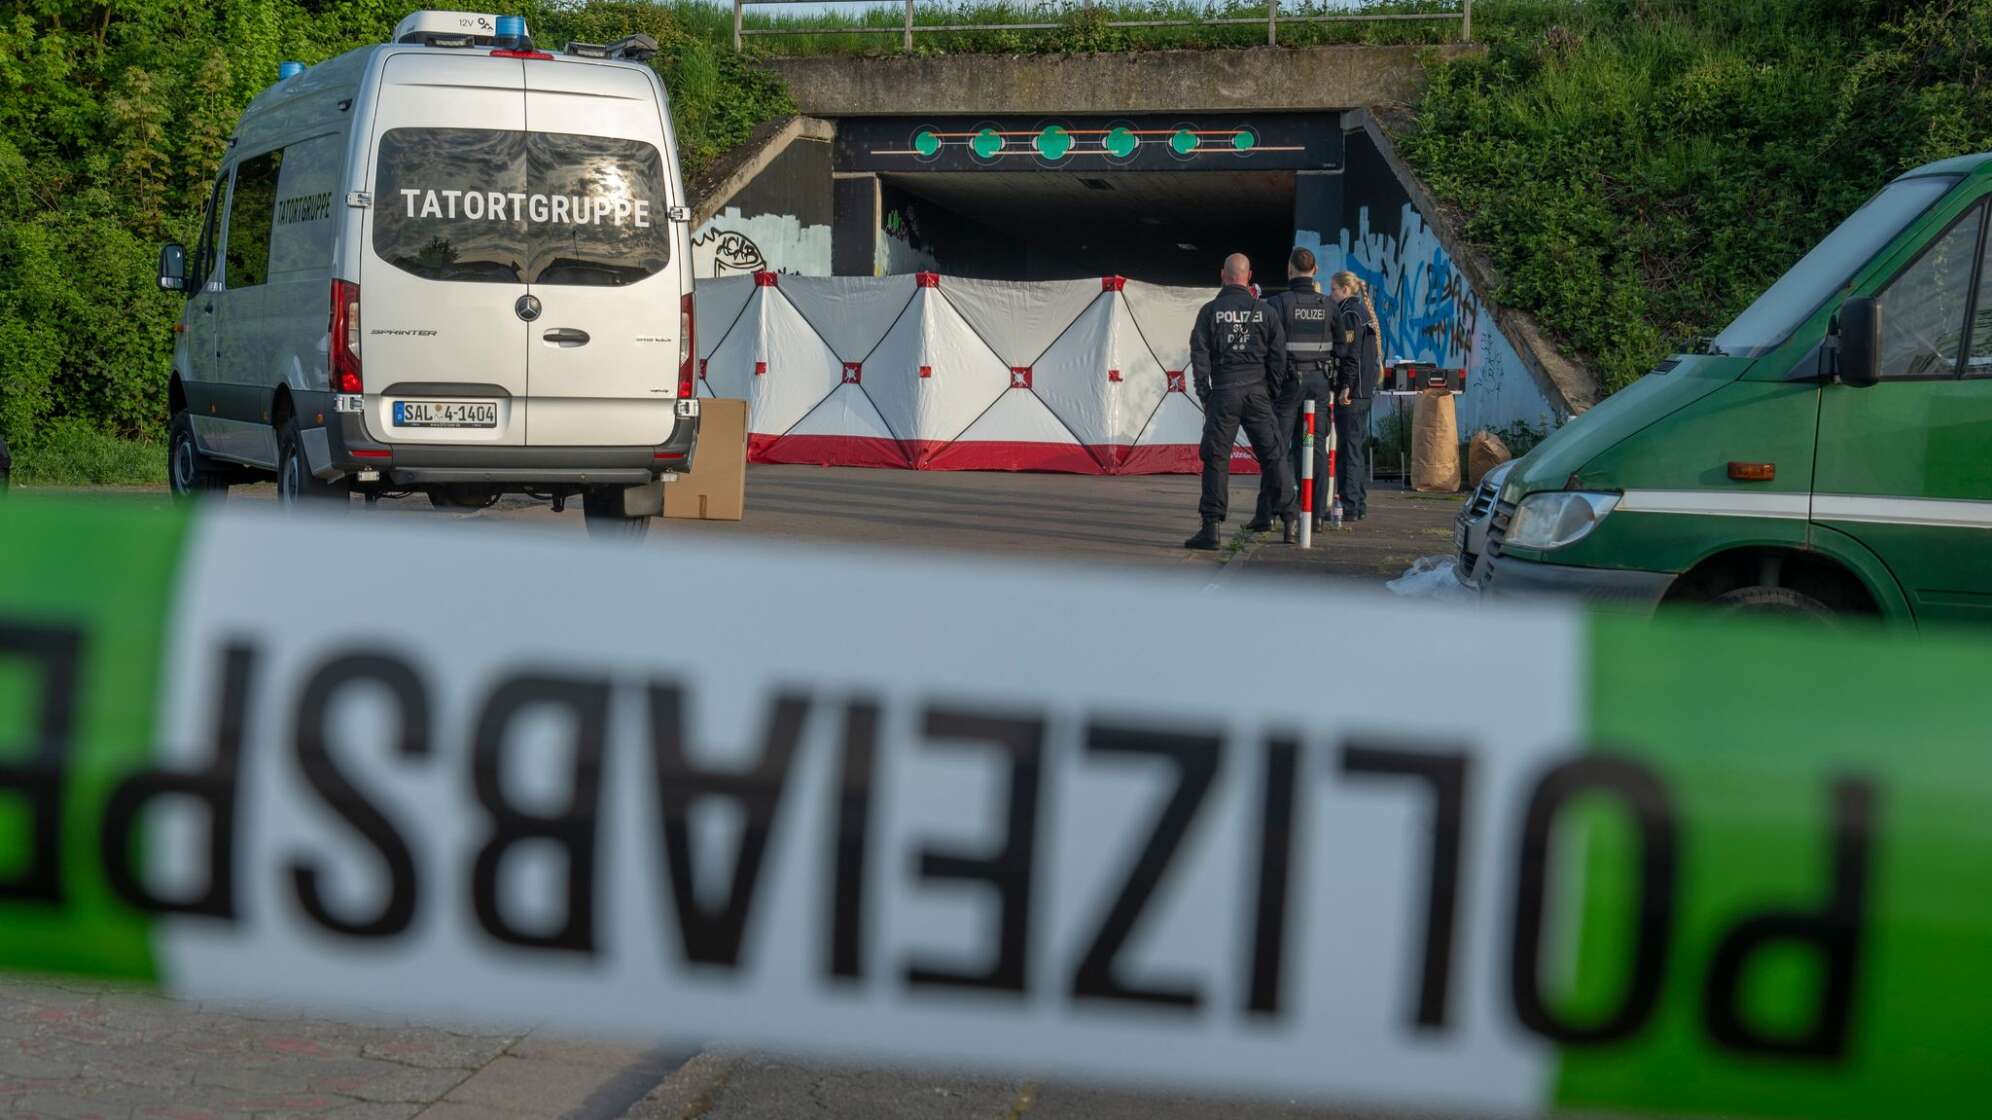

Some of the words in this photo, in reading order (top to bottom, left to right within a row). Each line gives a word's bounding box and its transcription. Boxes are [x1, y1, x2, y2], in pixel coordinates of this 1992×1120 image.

[277, 191, 333, 225] TATORTGRUPPE
[400, 188, 650, 229] TATORTGRUPPE
[1215, 310, 1264, 324] POLIZEI
[1295, 308, 1326, 320] POLIZEI
[404, 404, 433, 421] SAL
[444, 405, 494, 422] 4-1404
